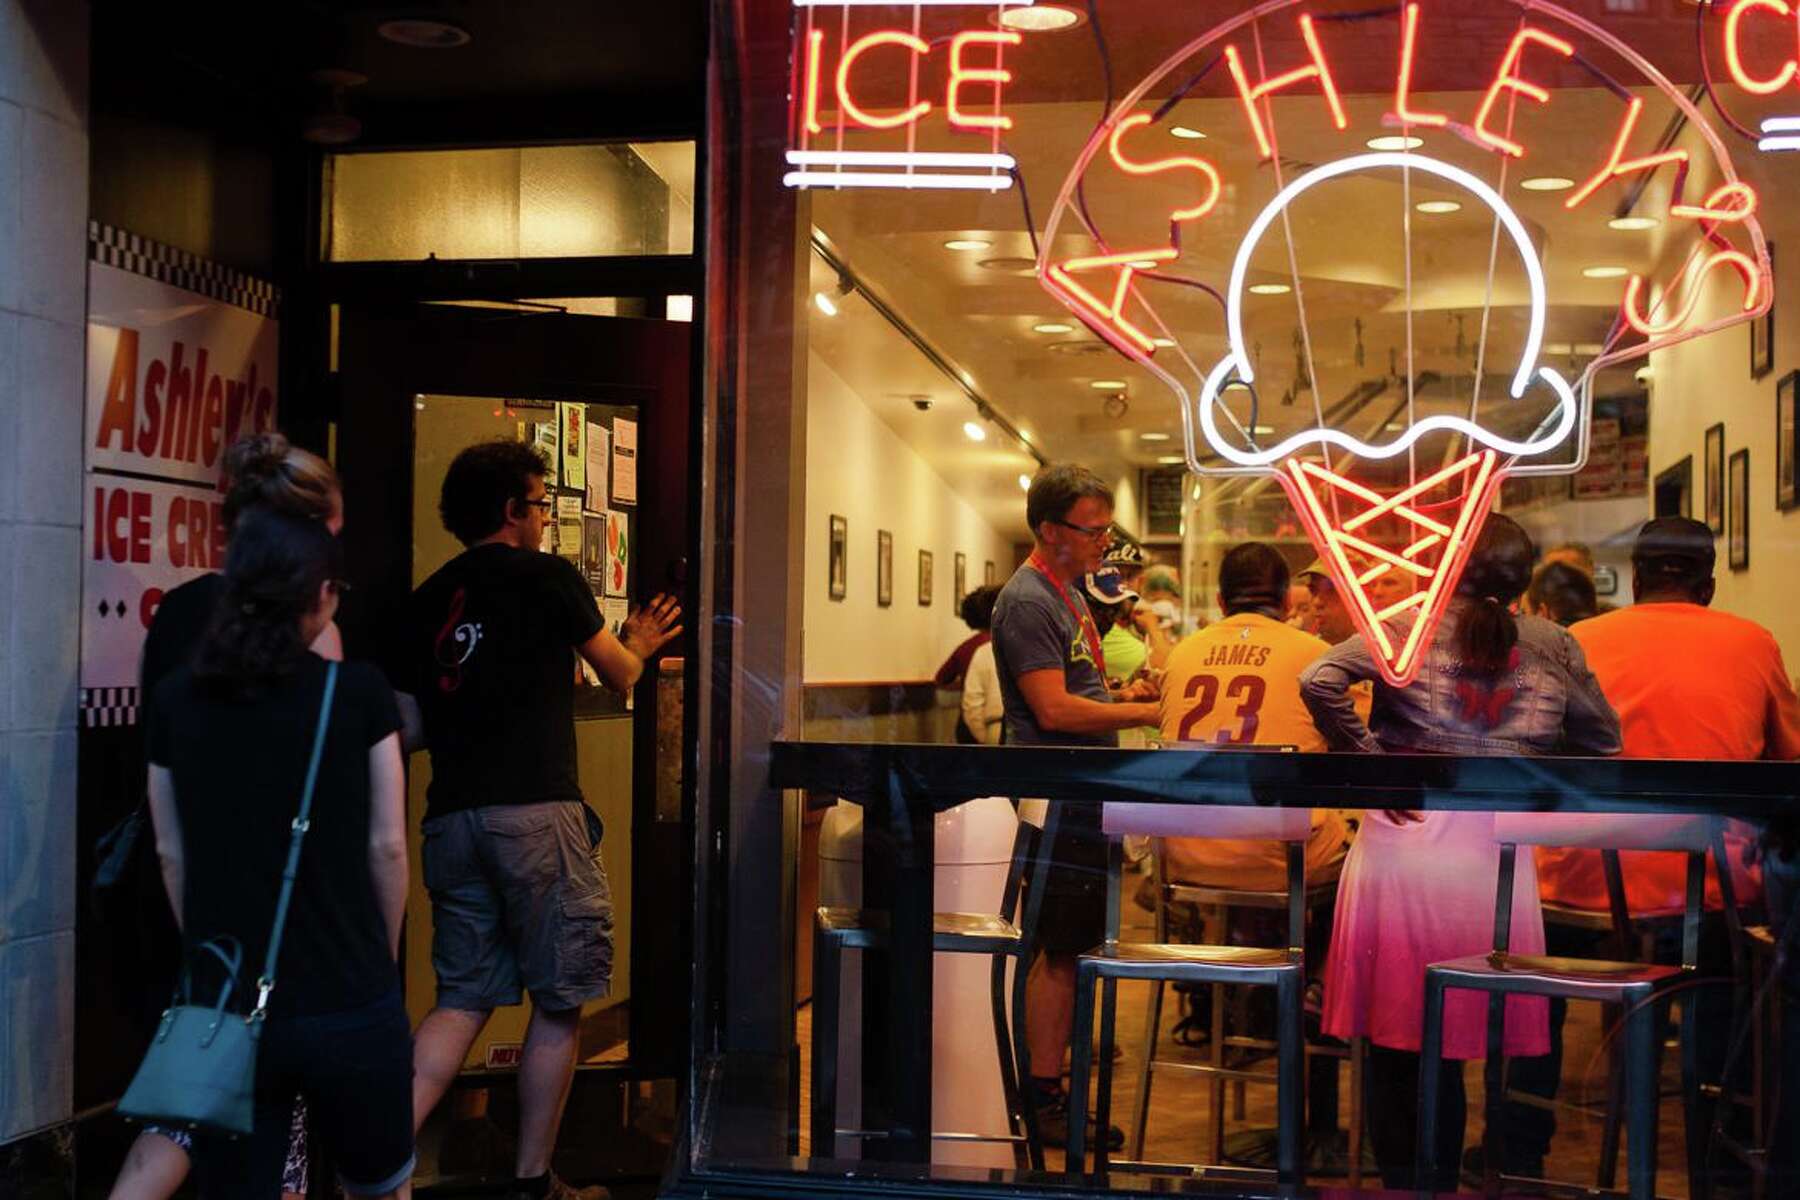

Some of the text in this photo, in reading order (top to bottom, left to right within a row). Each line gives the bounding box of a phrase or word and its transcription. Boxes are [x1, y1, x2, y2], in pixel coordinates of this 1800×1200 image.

[803, 28, 1023, 134] ICE
[1724, 0, 1800, 94] C
[1047, 1, 1756, 356] ASHLEY'S
[94, 486, 228, 569] ICE CRE
[1203, 644, 1271, 667] JAMES
[1177, 674, 1266, 744] 23
